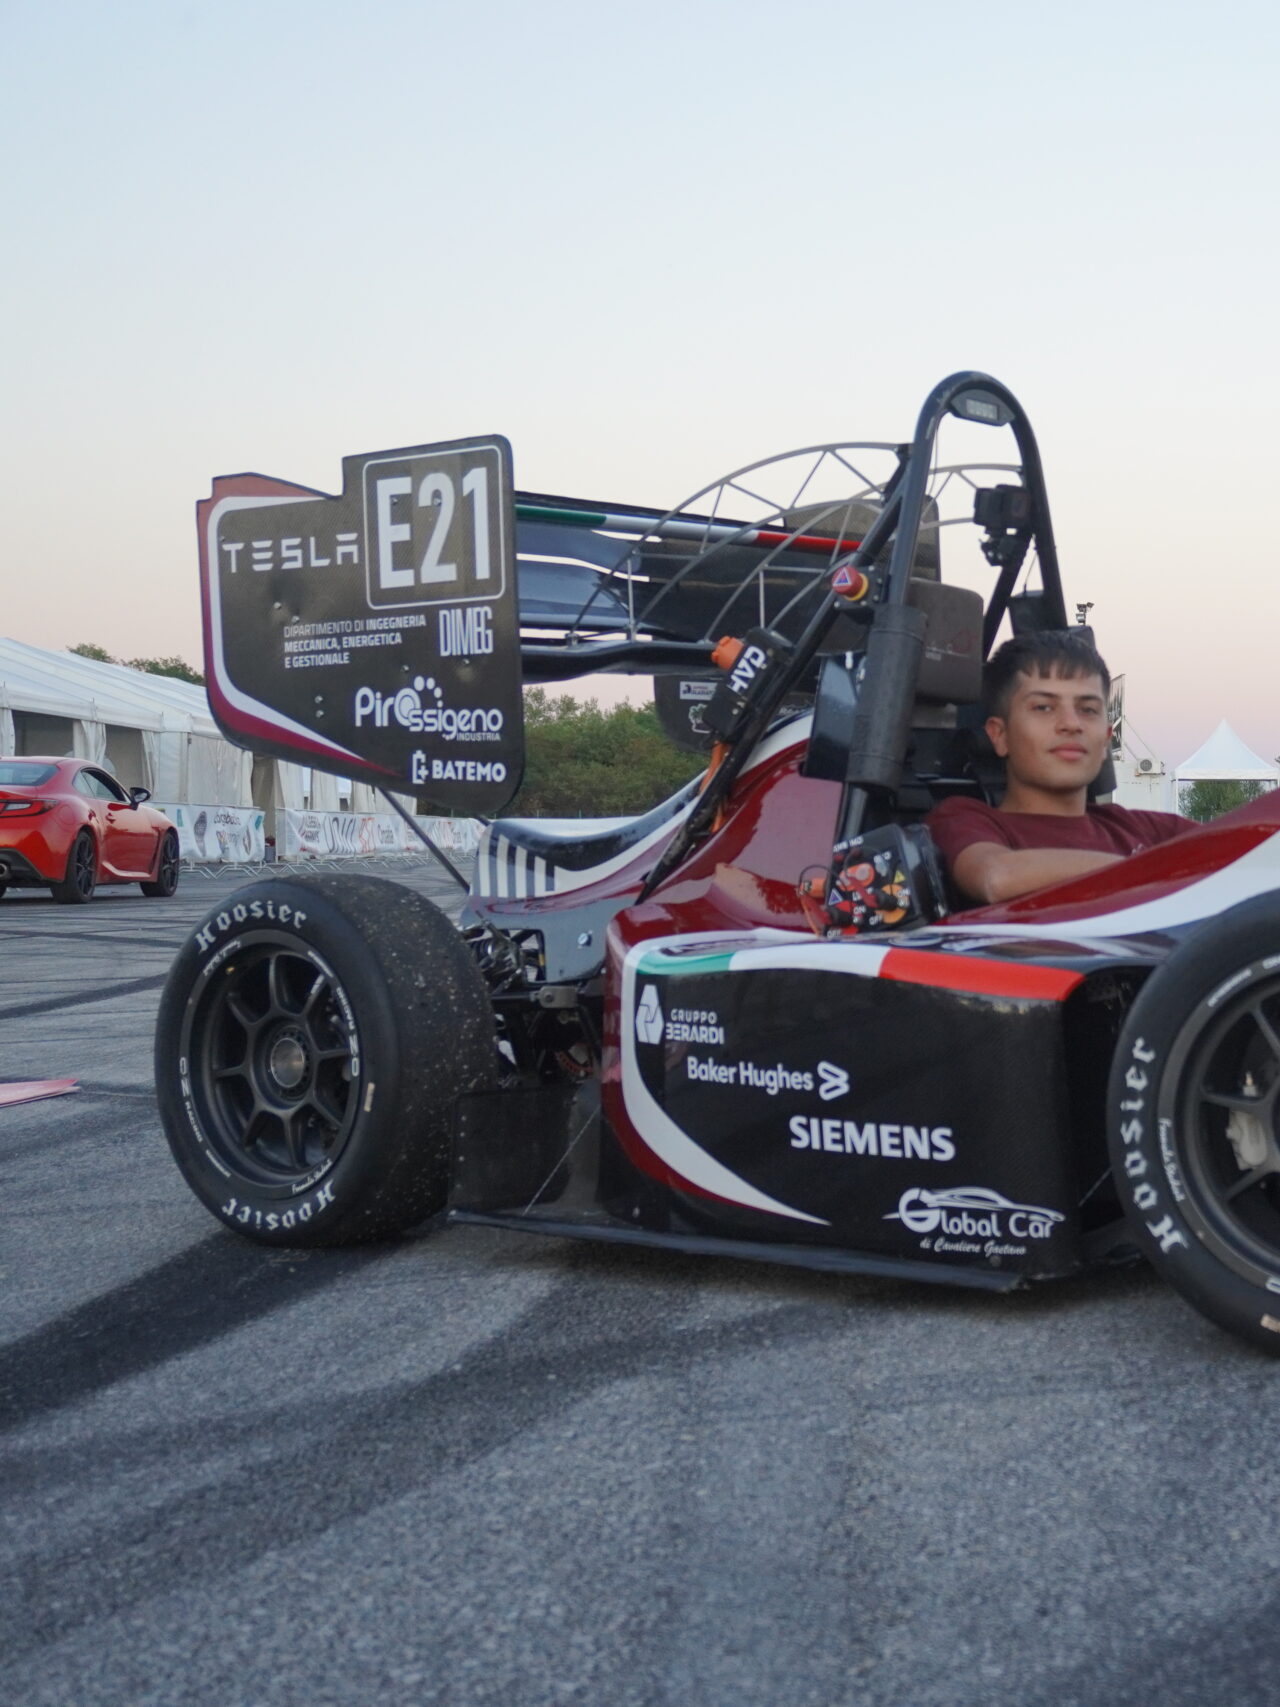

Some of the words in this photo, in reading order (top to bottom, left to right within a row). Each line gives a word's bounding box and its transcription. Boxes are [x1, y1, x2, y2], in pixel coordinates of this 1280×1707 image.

[377, 467, 490, 589] E21
[222, 533, 358, 573] TESLA
[283, 620, 353, 638] DIPARTIMENTO
[354, 619, 364, 632] DI
[365, 614, 427, 631] INGEGNERIA
[284, 635, 341, 653] MECCANICA,
[342, 632, 402, 649] ENERGETICA
[438, 606, 495, 657] DIMEG
[284, 657, 291, 668] E
[292, 652, 350, 668] GESTIONALE
[731, 645, 767, 693] HVD
[456, 732, 501, 742] INDUSTRIA
[432, 759, 507, 783] BATEMO
[195, 900, 307, 955] Hoosier
[665, 1023, 725, 1045] BERARDI
[670, 1008, 718, 1025] GRUPPO
[687, 1055, 737, 1084] Baker
[738, 1060, 815, 1096] Hughes
[788, 1114, 956, 1162] SIEMENS
[1120, 1037, 1188, 1255] Hoosier
[221, 1179, 337, 1231] Hoosier
[898, 1187, 1002, 1238] Global
[1008, 1211, 1054, 1238] Car
[919, 1236, 932, 1249] di
[933, 1236, 982, 1253] Cavaliere
